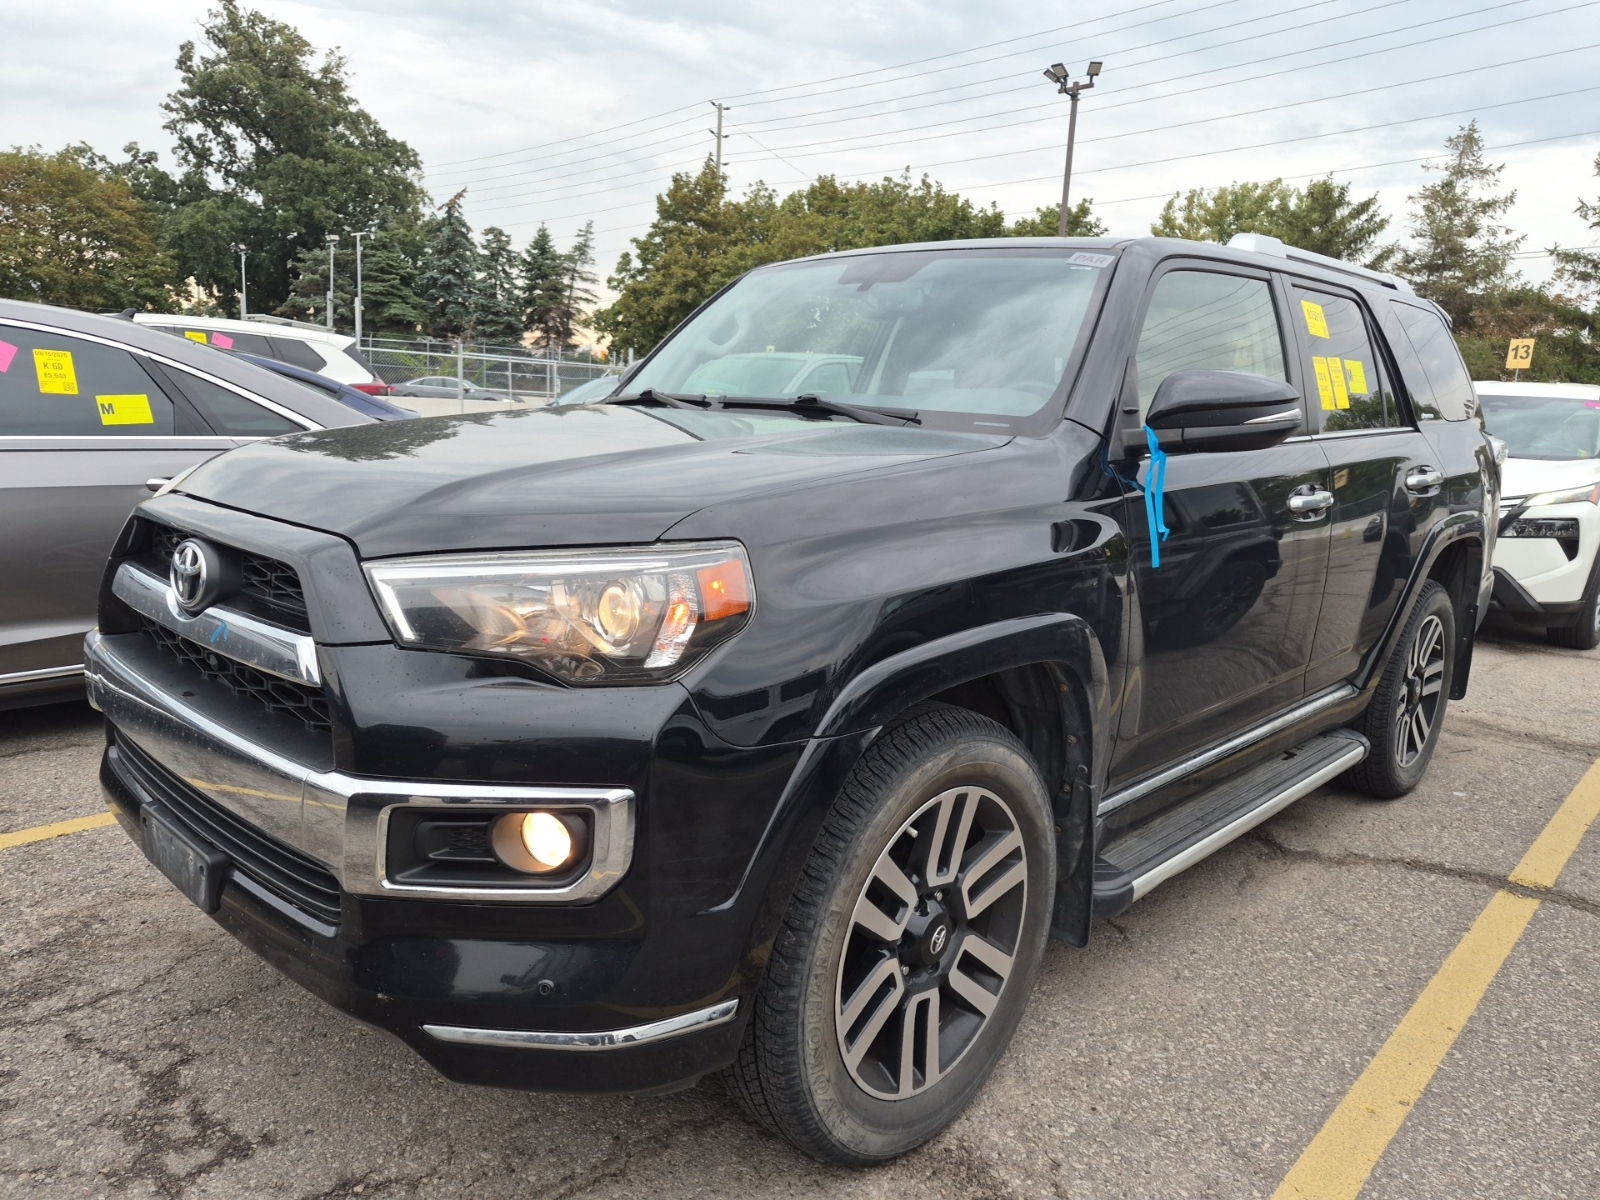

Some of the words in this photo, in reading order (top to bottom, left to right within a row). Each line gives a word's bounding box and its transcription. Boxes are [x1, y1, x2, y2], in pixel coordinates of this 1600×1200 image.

[1074, 254, 1107, 264] PAR
[1511, 345, 1531, 360] 13
[43, 362, 50, 370] K
[52, 362, 63, 370] 60
[100, 403, 115, 415] M
[805, 906, 842, 1121] YOKOHAMA
